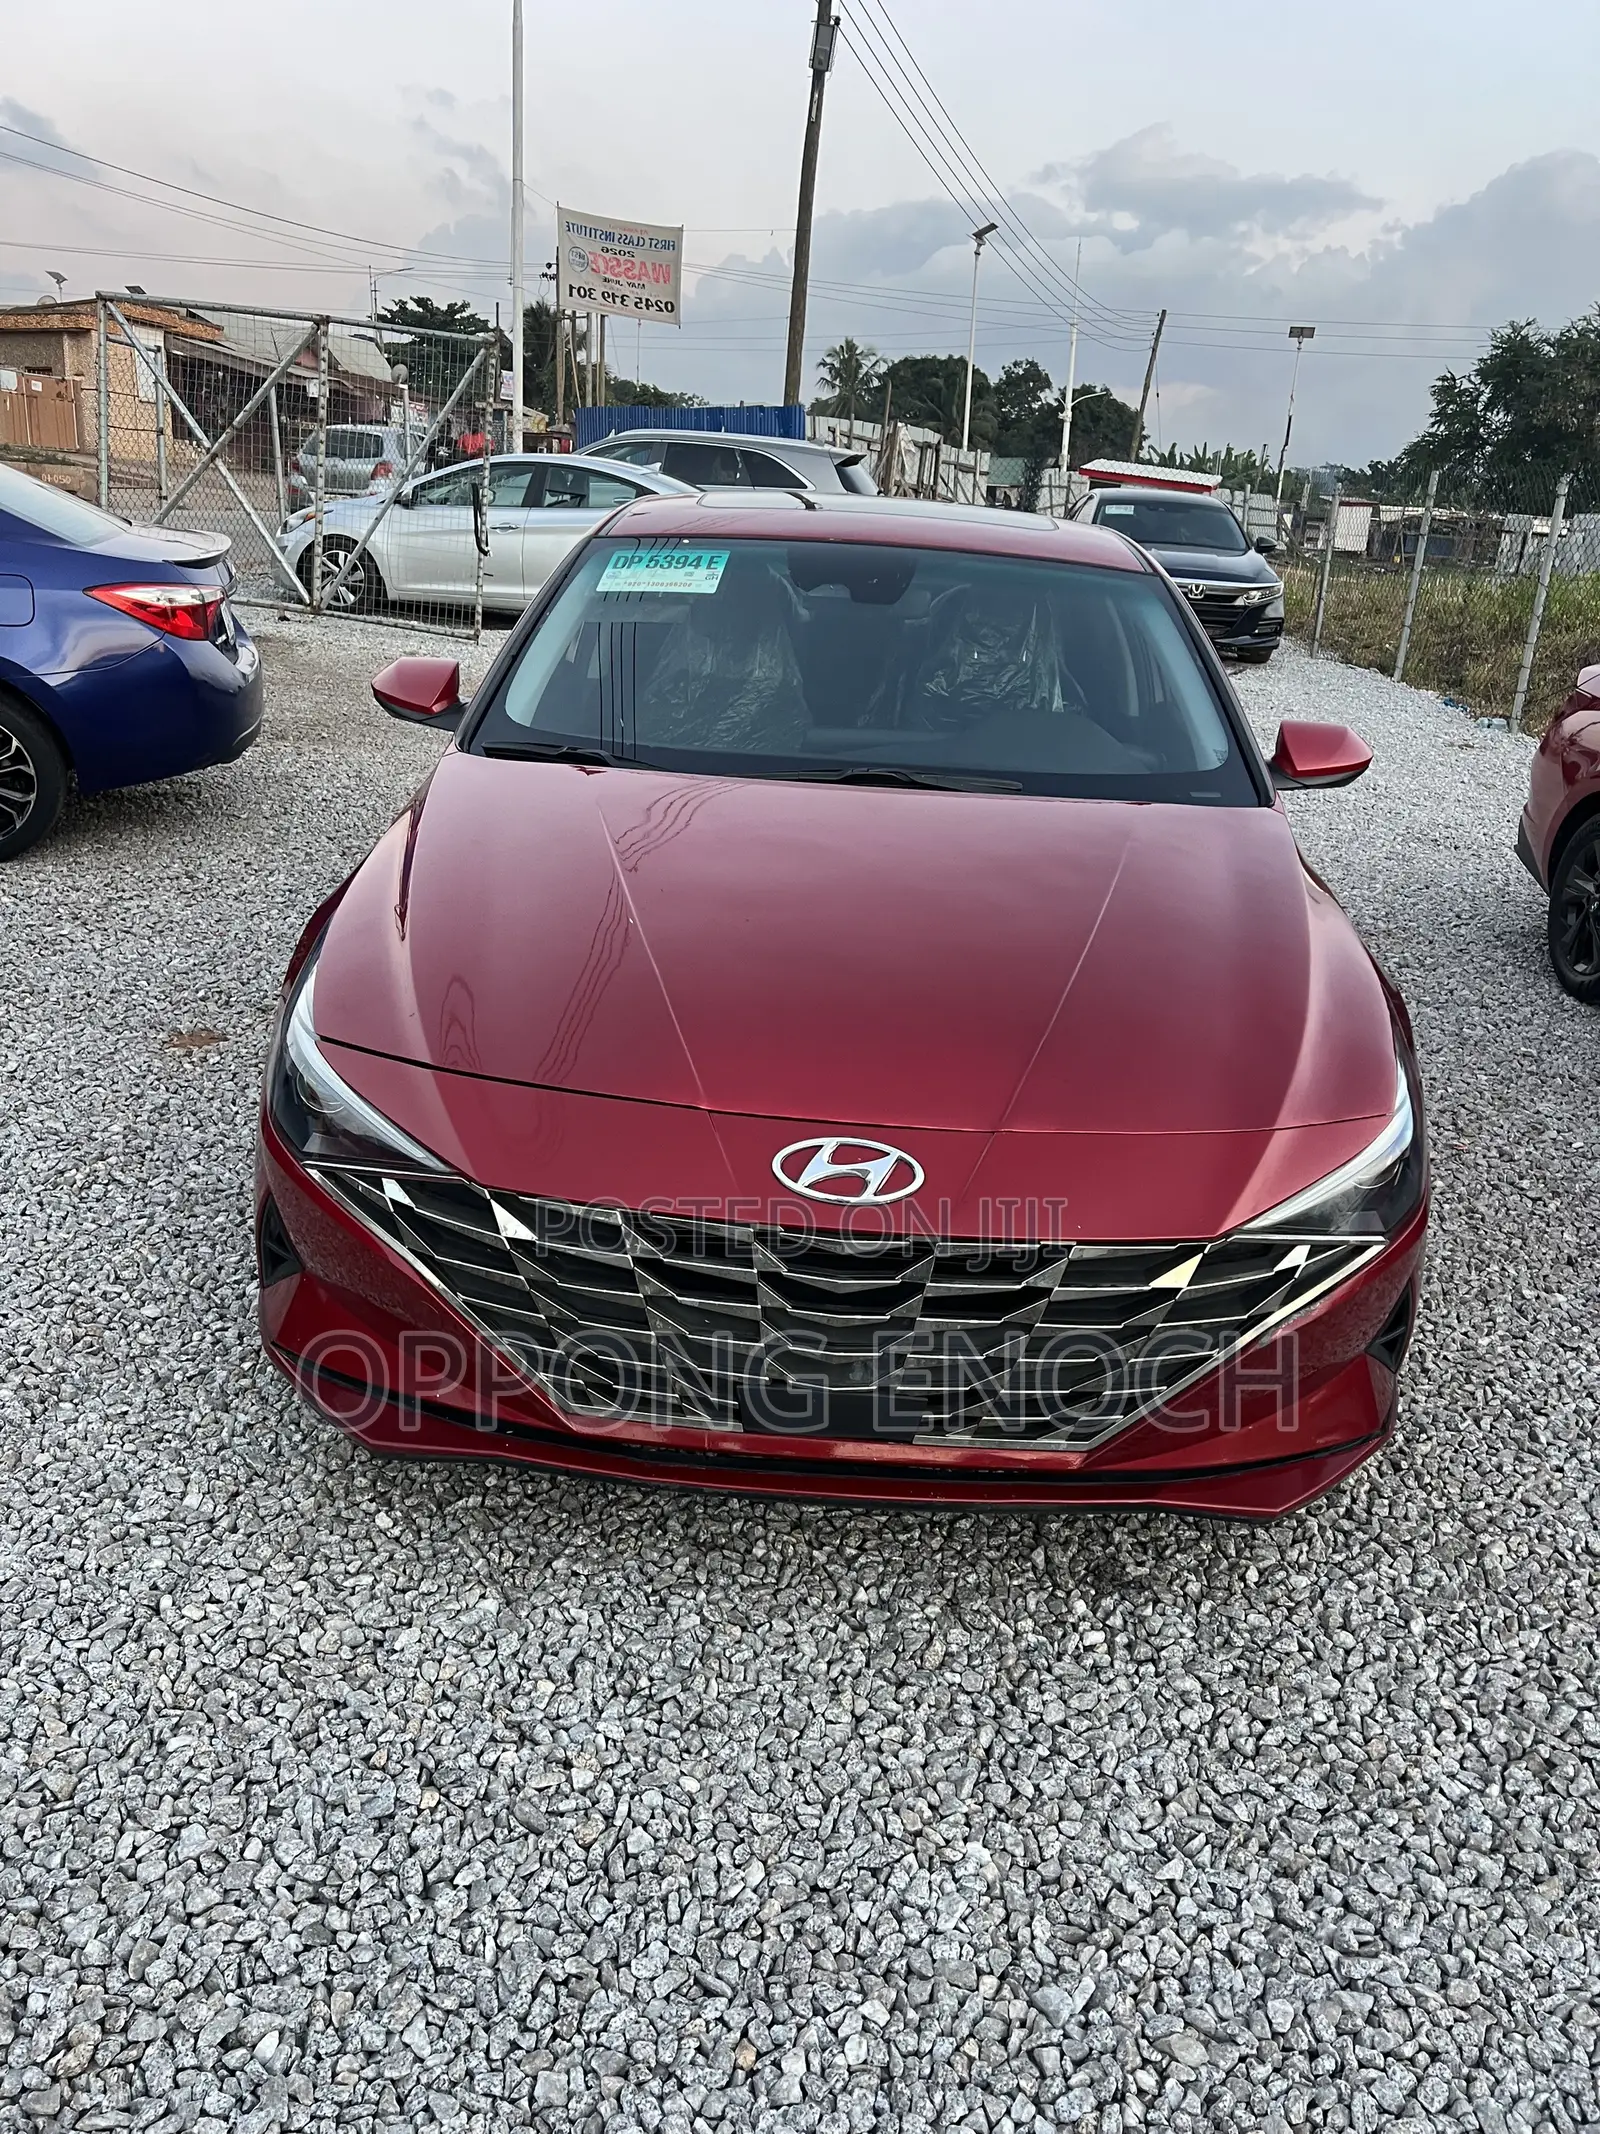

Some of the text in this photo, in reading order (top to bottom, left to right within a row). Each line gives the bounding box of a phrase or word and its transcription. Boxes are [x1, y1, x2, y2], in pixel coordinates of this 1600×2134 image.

[612, 555, 723, 570] DP 5394 E
